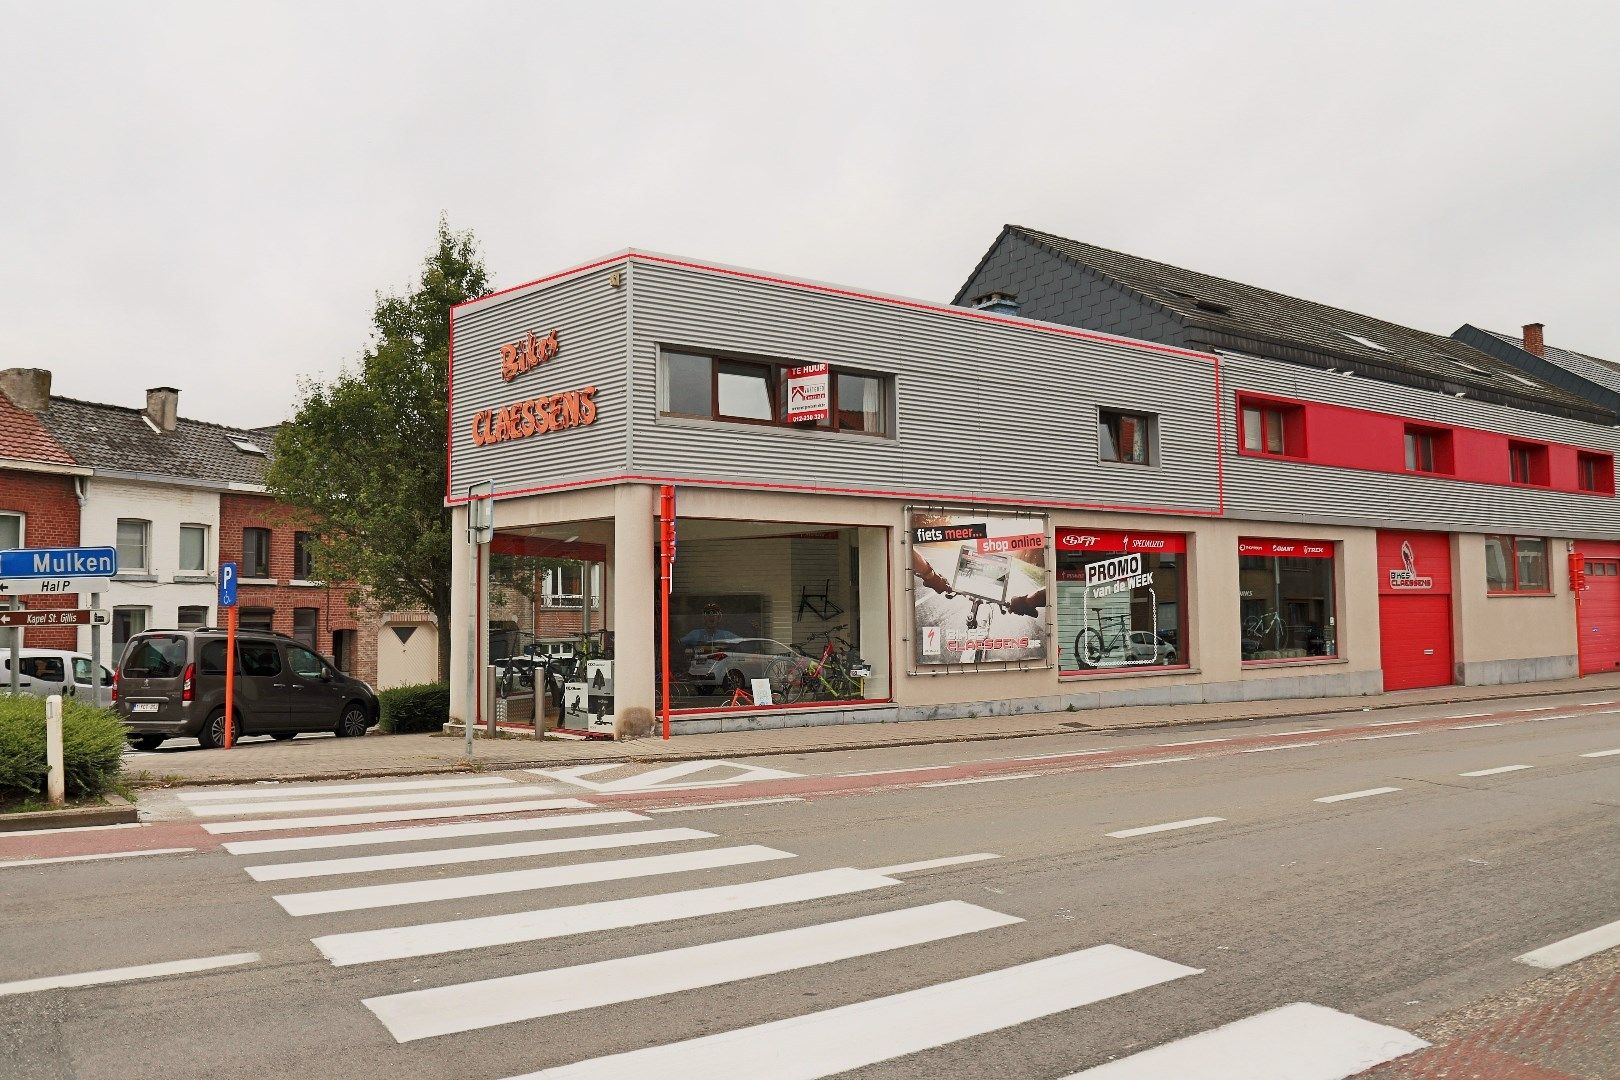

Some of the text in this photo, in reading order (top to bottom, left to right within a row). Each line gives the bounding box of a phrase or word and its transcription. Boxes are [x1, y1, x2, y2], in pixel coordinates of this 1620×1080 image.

[500, 329, 559, 382] Bikes
[803, 364, 825, 373] HUUR
[471, 385, 598, 447] CLAESSENS
[916, 528, 982, 541] fiets meer...
[982, 536, 1042, 552] shop online
[1132, 539, 1165, 548] SPECIALIZED
[33, 553, 111, 573] Mulken
[1088, 557, 1139, 583] PROMO
[224, 566, 232, 589] P
[1092, 571, 1154, 599] van de WEEK
[41, 580, 71, 592] Hal P
[26, 612, 77, 625] Kapel St. Gillis
[946, 637, 1029, 652] CLAESSENS
